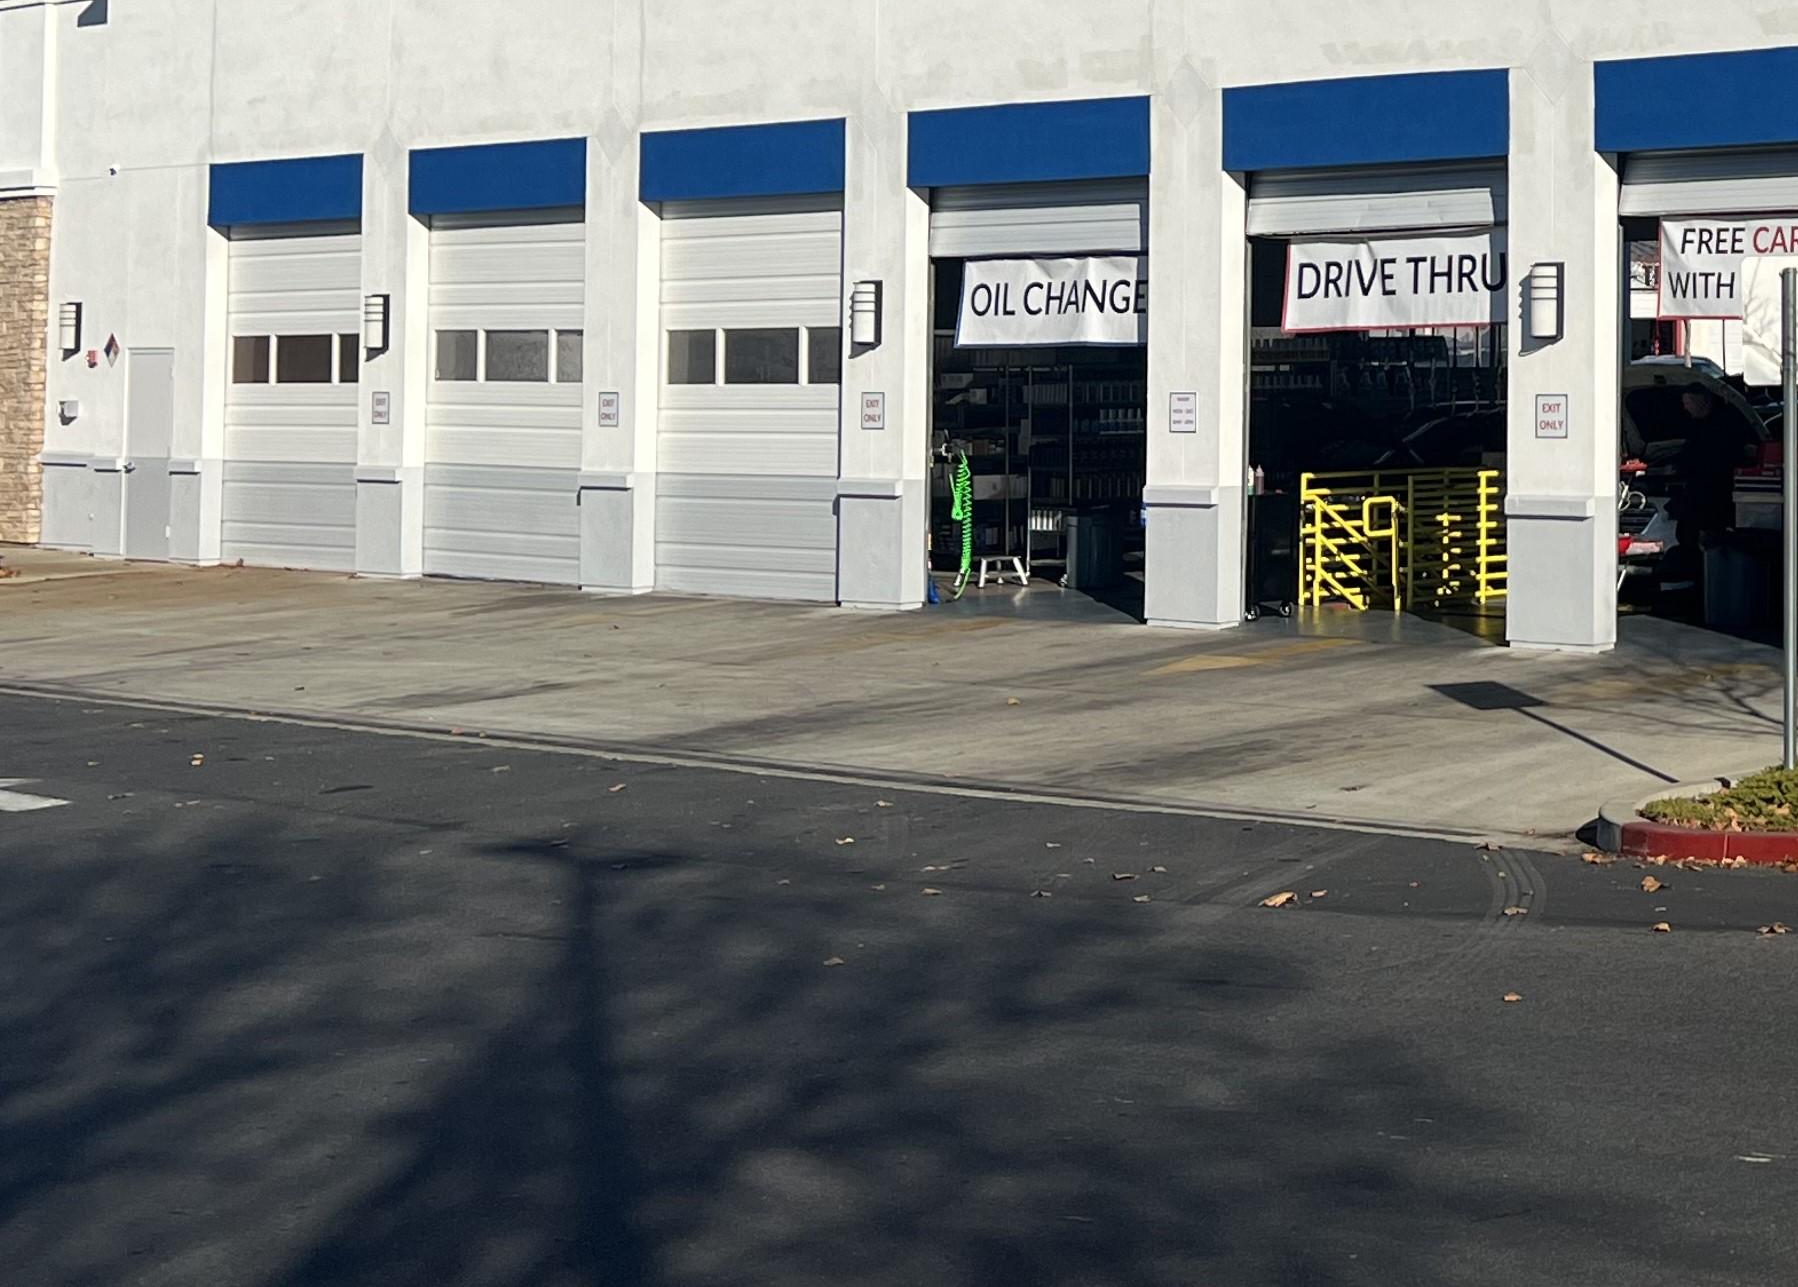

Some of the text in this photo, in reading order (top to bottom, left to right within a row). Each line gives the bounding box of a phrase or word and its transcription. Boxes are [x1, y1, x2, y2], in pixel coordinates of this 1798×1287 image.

[1680, 227, 1746, 255] FREE
[1297, 252, 1508, 299] DRIVE THRU
[1667, 271, 1735, 299] WITH
[971, 279, 1148, 317] OIL CHANGE
[1542, 403, 1561, 413] EXIT
[1539, 420, 1564, 430] ONLY
